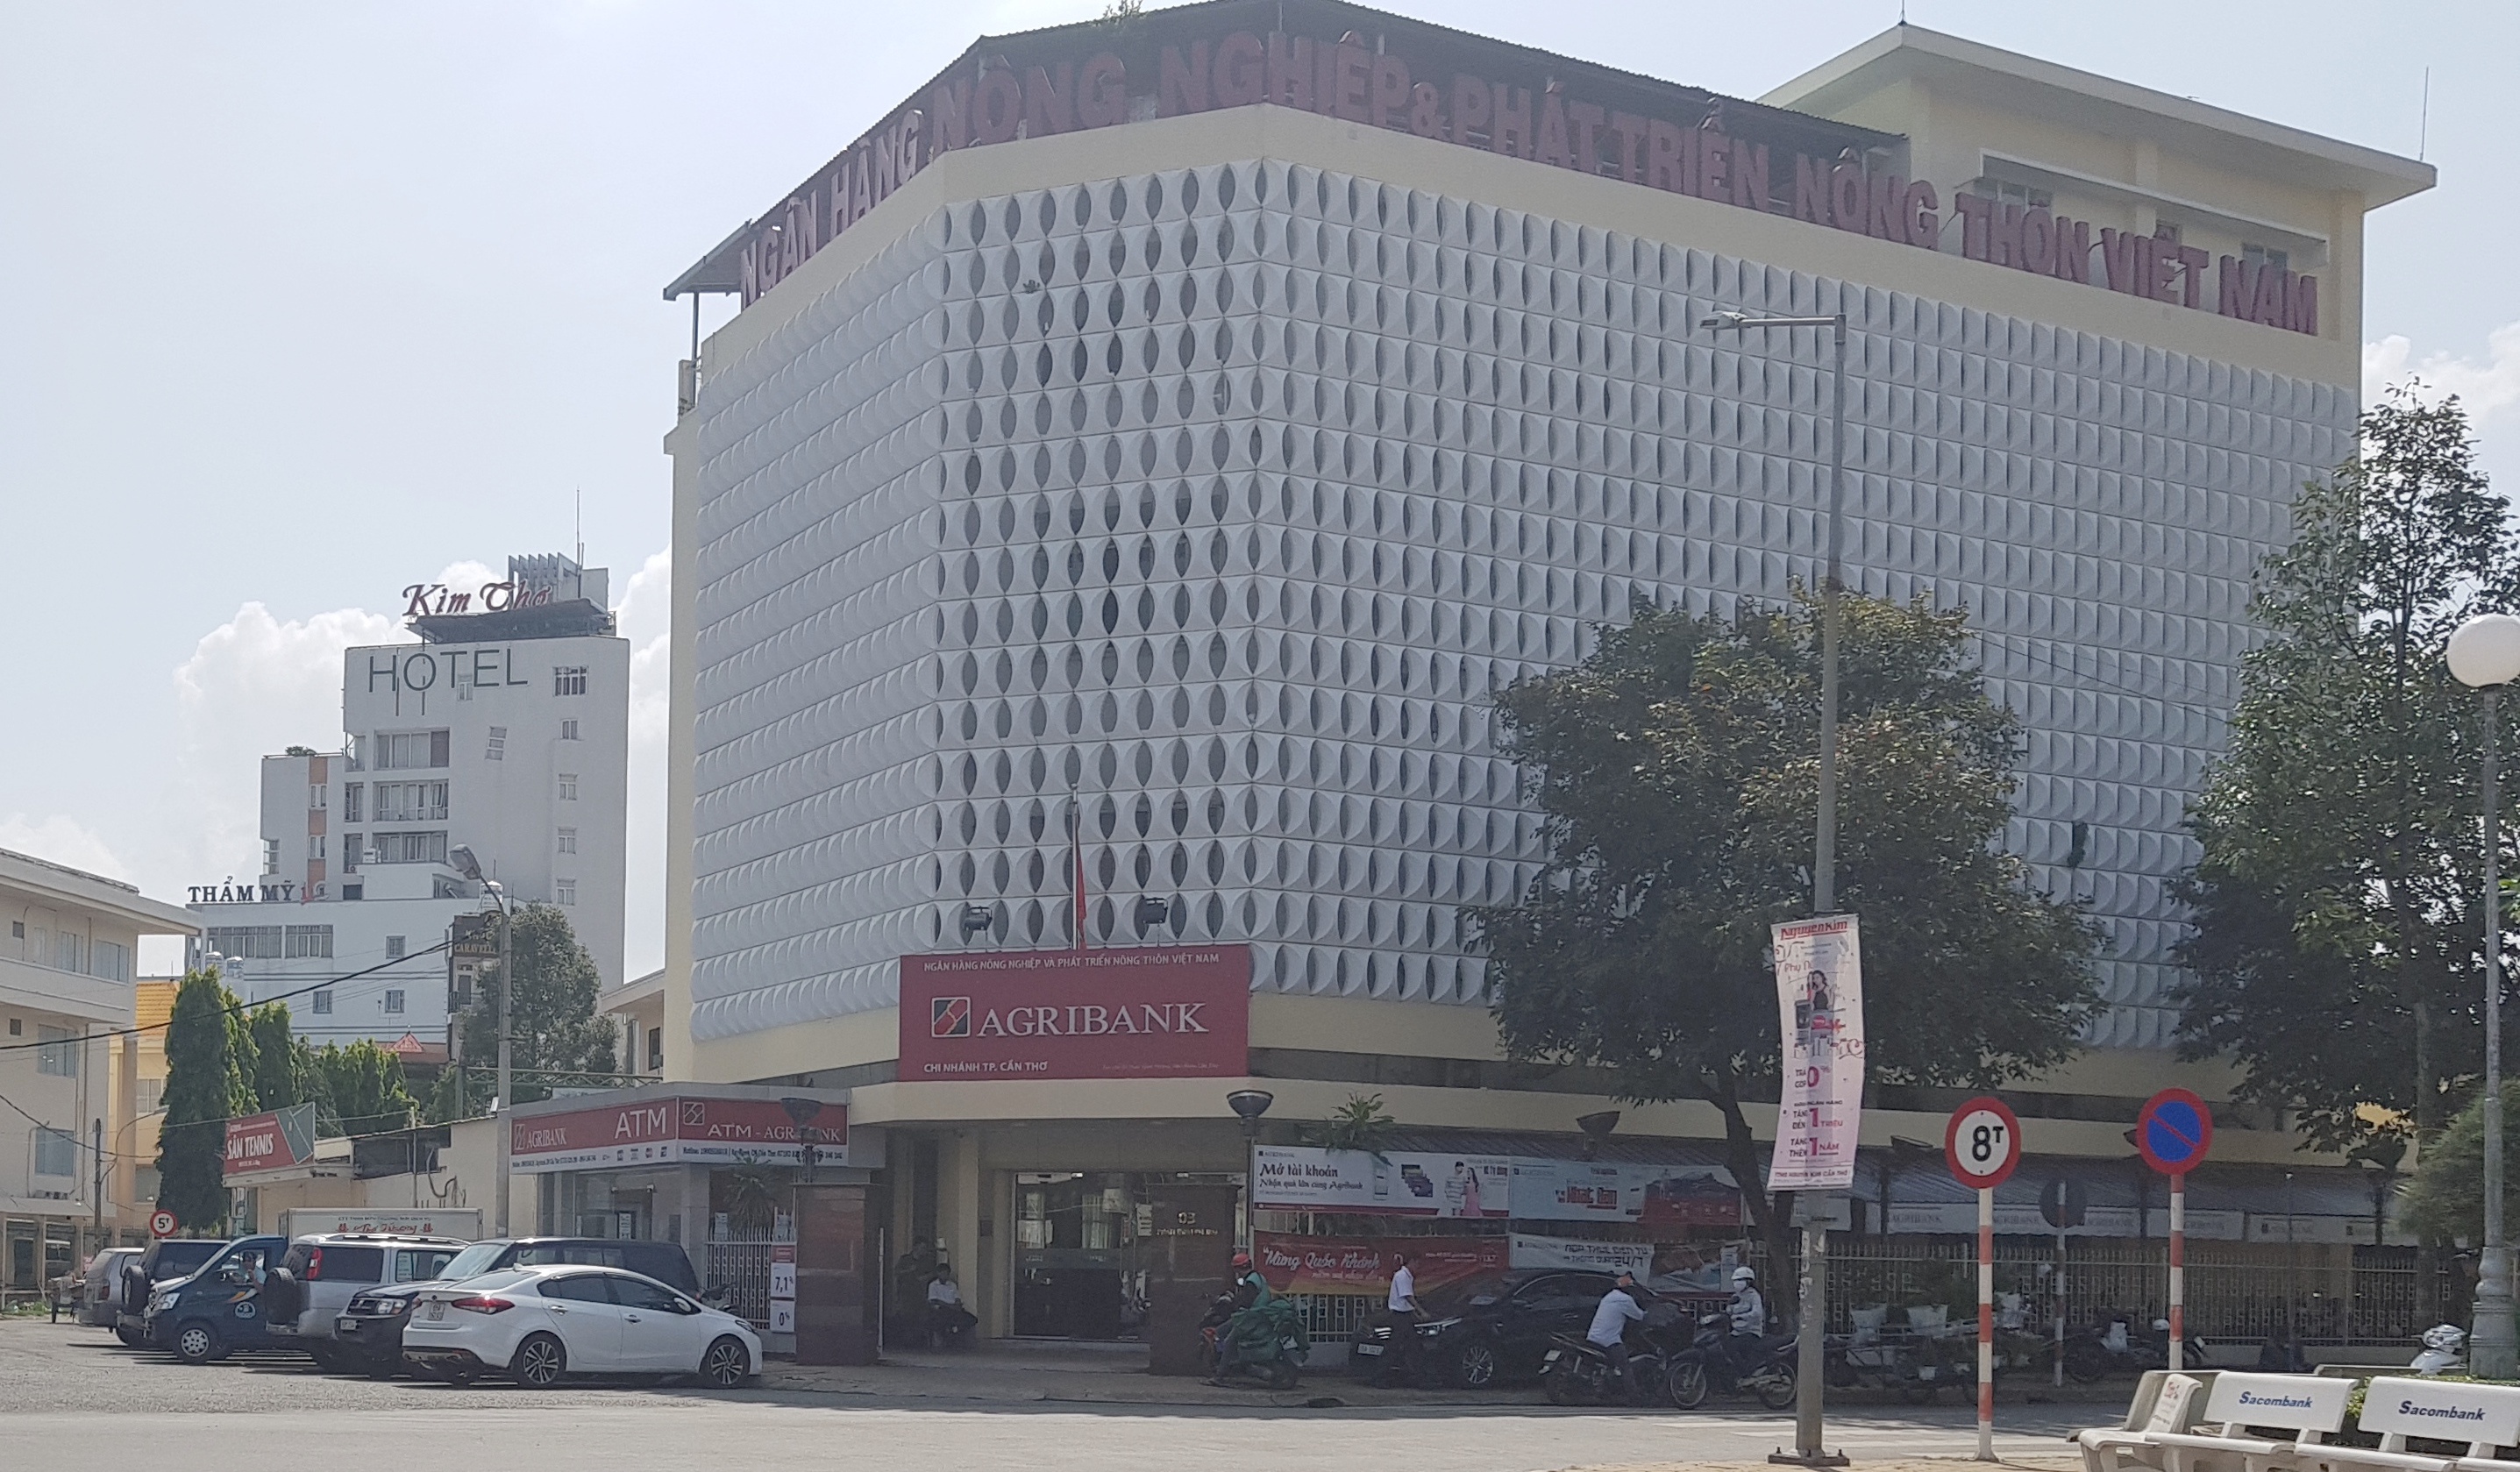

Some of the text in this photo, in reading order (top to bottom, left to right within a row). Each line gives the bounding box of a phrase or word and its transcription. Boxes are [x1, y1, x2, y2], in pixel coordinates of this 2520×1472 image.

[741, 196, 817, 307] NGÂN
[932, 54, 1127, 153] NÔNG
[1411, 82, 1450, 140] &
[1453, 74, 1605, 174] PHÁT
[1796, 146, 1940, 252] NÔNG
[1954, 191, 2090, 285] THÔN
[2219, 254, 2318, 337] NAM
[402, 583, 472, 616] Kim
[368, 648, 528, 693] HOTEL
[188, 876, 254, 902] THẨM
[260, 879, 295, 901] MỸ
[923, 960, 950, 972] NGÂN
[951, 959, 979, 971] HÀNG
[979, 958, 1007, 970] NÔNG
[1008, 956, 1041, 971] NGHIỆP
[1043, 956, 1056, 968] VÀ
[1057, 956, 1082, 968] PHÁT
[1085, 953, 1112, 967] TRIỂN
[1113, 954, 1140, 965] NÔNG
[1143, 953, 1170, 964] THÔN
[1195, 953, 1220, 964] NAM
[977, 1002, 1209, 1038] AGRIBANK
[923, 1058, 1049, 1073] CHI NHÁNH TP. CẦN THƠ
[615, 1106, 667, 1140] ATM
[707, 1123, 752, 1139] ATM
[763, 1125, 842, 1142] AGRNK
[245, 1133, 274, 1158] TENNIS
[526, 1127, 567, 1149] AGRIBANK
[1259, 1163, 1285, 1177] Mở
[1287, 1163, 1302, 1177] tài
[2239, 1390, 2314, 1408] Sacombank
[2398, 1400, 2486, 1421] Sacombank
